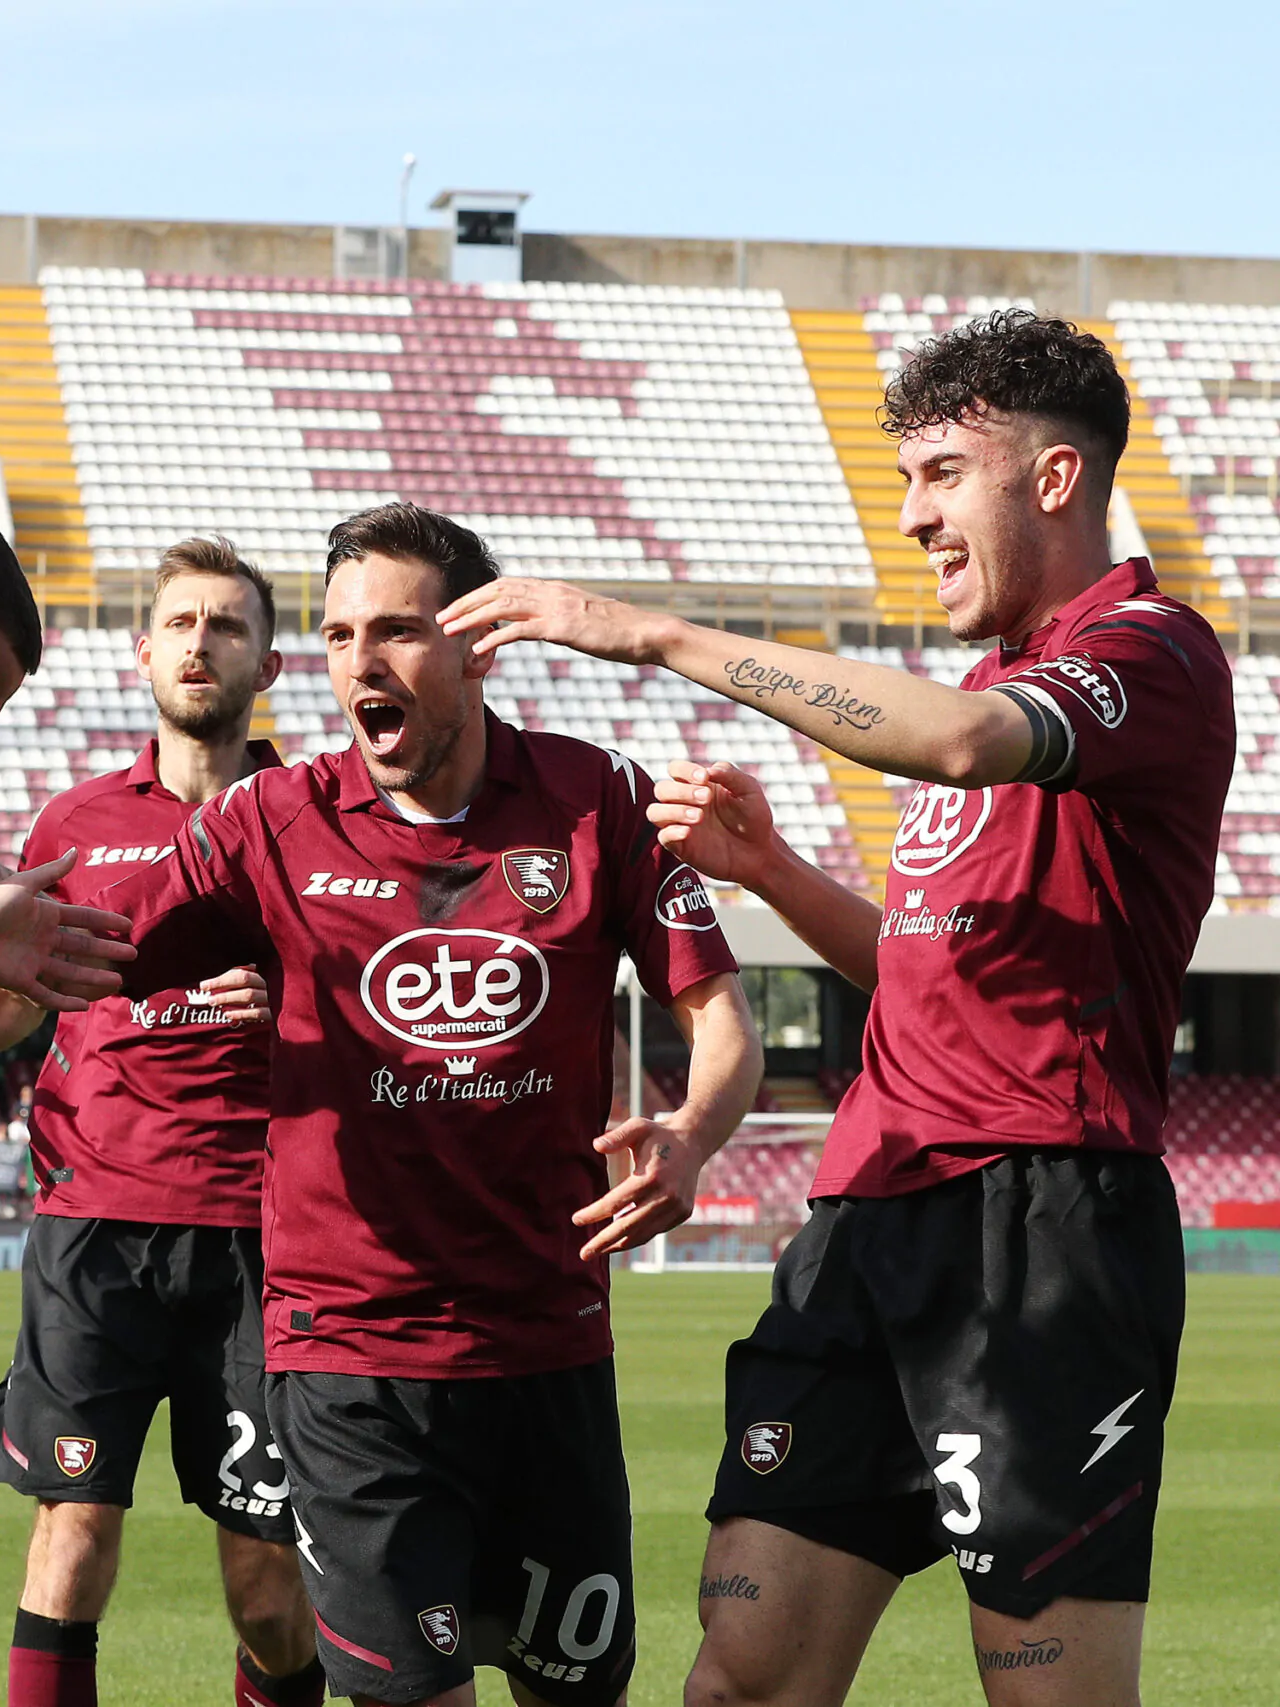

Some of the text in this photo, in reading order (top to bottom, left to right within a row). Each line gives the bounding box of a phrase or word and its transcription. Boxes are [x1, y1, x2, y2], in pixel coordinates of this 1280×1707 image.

[724, 658, 887, 731] Carpe Diem
[84, 845, 159, 867] Zeus
[301, 872, 400, 899] Zeus
[523, 887, 549, 898] 1919
[665, 884, 710, 921] mott
[930, 904, 975, 941] Art
[384, 940, 522, 1021] eté
[410, 1016, 507, 1038] supermercati
[370, 1066, 554, 1109] Re d'Italia Art
[750, 1453, 772, 1462] 1919
[219, 1487, 283, 1517] Zeus
[934, 1433, 982, 1535] 3
[521, 1556, 620, 1661] 10
[508, 1636, 587, 1683] Zeus
